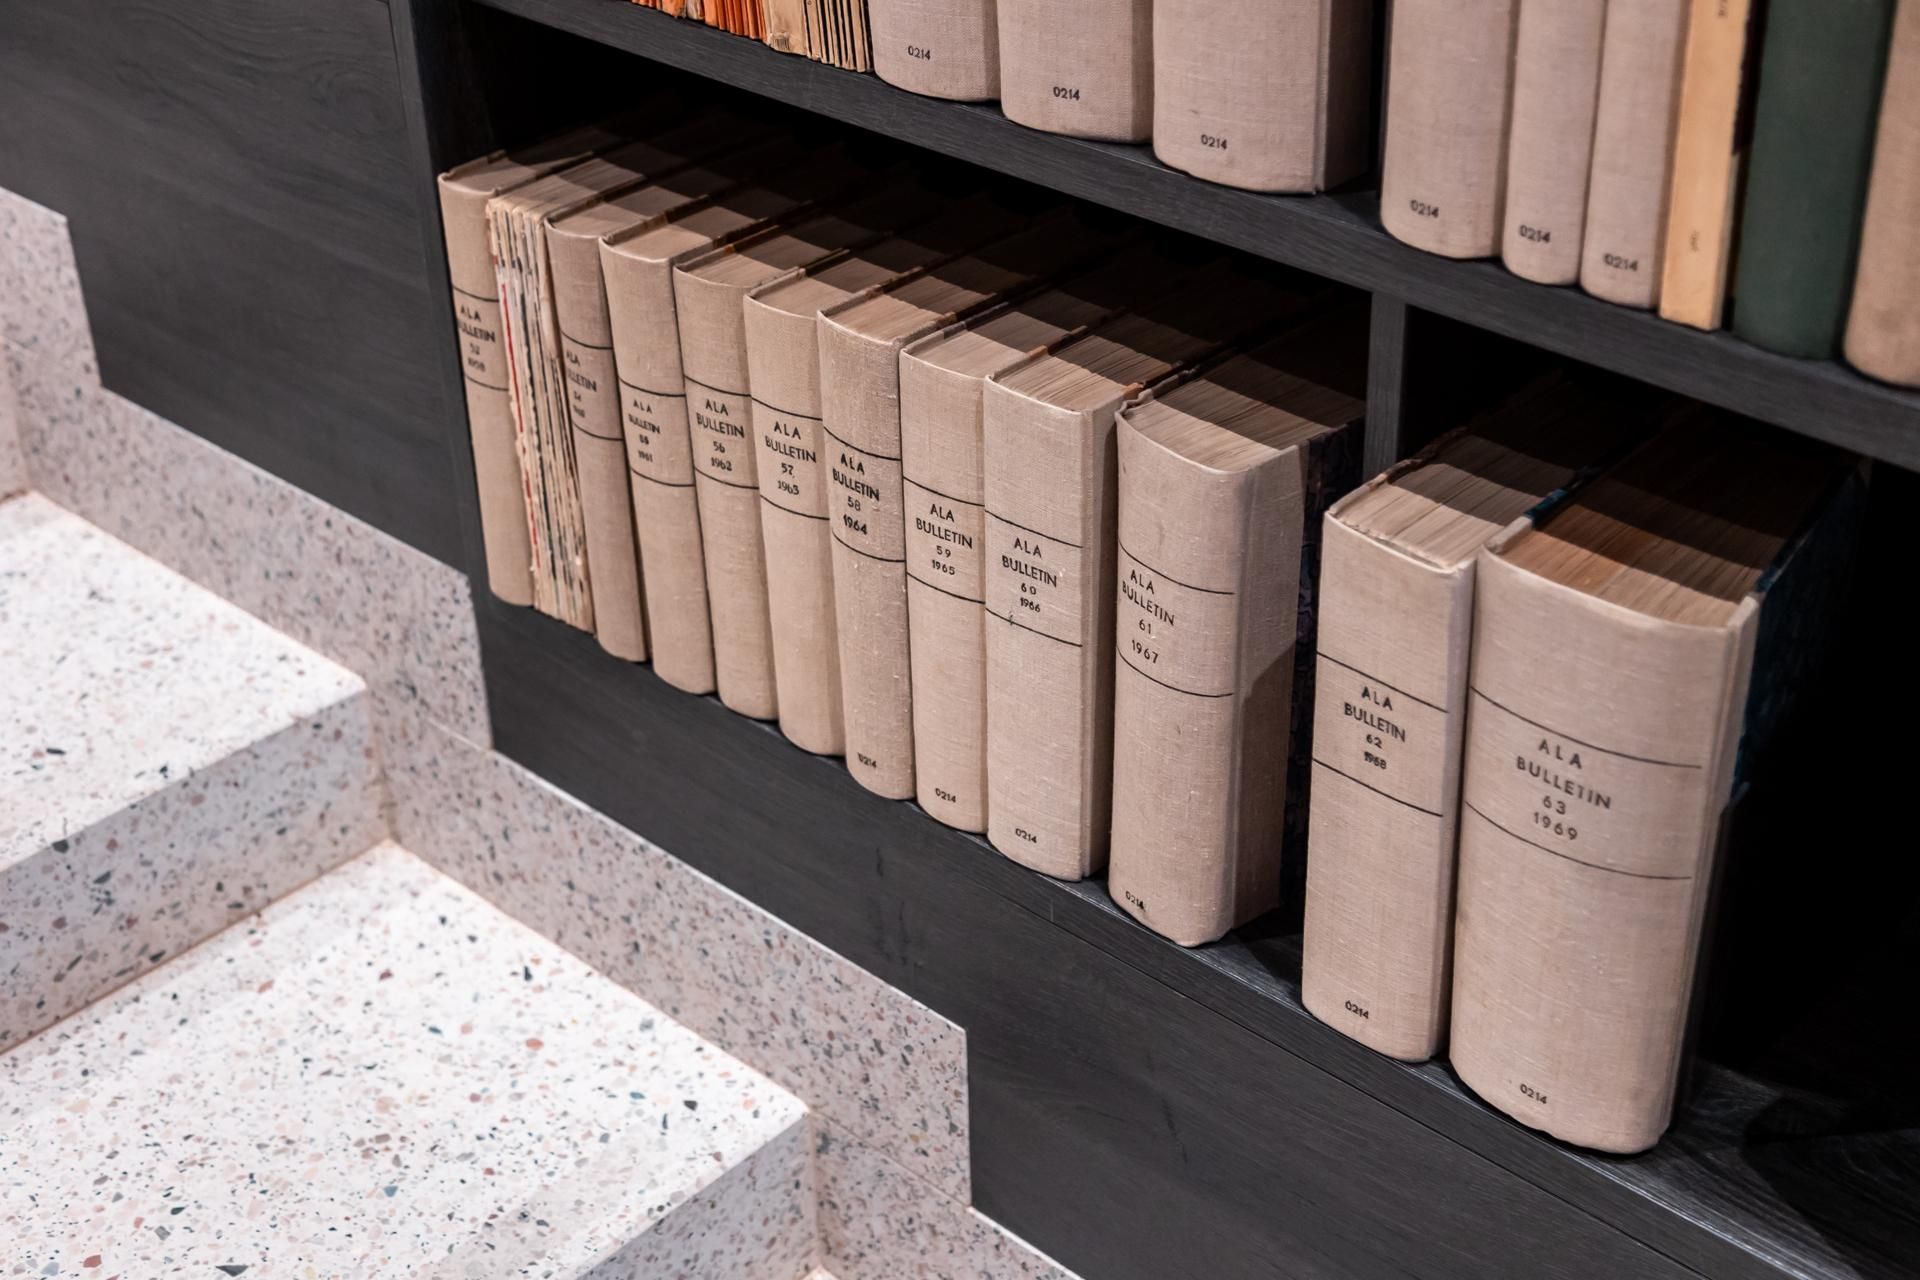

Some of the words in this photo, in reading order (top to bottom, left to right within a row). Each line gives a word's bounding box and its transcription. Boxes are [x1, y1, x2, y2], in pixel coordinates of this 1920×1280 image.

[907, 45, 931, 60] 0214
[1053, 86, 1080, 101] 0214
[1200, 134, 1228, 150] 0214
[1410, 200, 1440, 218] 0214
[1519, 224, 1551, 243] 0214
[1604, 253, 1638, 271] 0214
[461, 305, 481, 322] ALA
[633, 399, 653, 414] ALA
[705, 399, 729, 416] ALA
[628, 413, 661, 434] BULLETIN
[696, 412, 745, 438] BULLETIN
[774, 421, 802, 440] ALA
[713, 441, 725, 454] 56
[764, 435, 817, 463] BULLETIN
[711, 457, 732, 471] 1962
[840, 453, 865, 475] ALA
[777, 480, 800, 495] 1963
[832, 468, 880, 501] BULLETIN
[847, 496, 861, 511] 58
[930, 503, 955, 523] ALA
[843, 514, 868, 535] 1964
[915, 517, 973, 549] BULLETIN
[936, 545, 952, 558] 59
[1014, 537, 1042, 558] ALA
[932, 559, 956, 576] 1965
[1002, 555, 1057, 588] BULLETIN
[1020, 582, 1037, 596] 60
[1130, 569, 1154, 595] ALA
[1020, 597, 1041, 613] 1966
[1121, 580, 1175, 627] BULLETIN
[1138, 618, 1151, 635] 61
[1131, 639, 1159, 664] 1967
[1361, 686, 1393, 711] ALA
[1344, 701, 1406, 743] BULLETIN
[1366, 734, 1382, 749] 62
[857, 752, 877, 769] 0214
[1364, 751, 1387, 770] 1968
[1538, 739, 1582, 769] ALA
[1516, 756, 1611, 809] BULLETIN
[935, 787, 957, 803] 0214
[1543, 795, 1566, 815] 63
[1534, 811, 1578, 840] 1969
[1015, 828, 1038, 843] 0214
[1125, 890, 1146, 912] 0214
[1345, 1000, 1369, 1020] 0214
[1520, 1084, 1547, 1105] 0214
